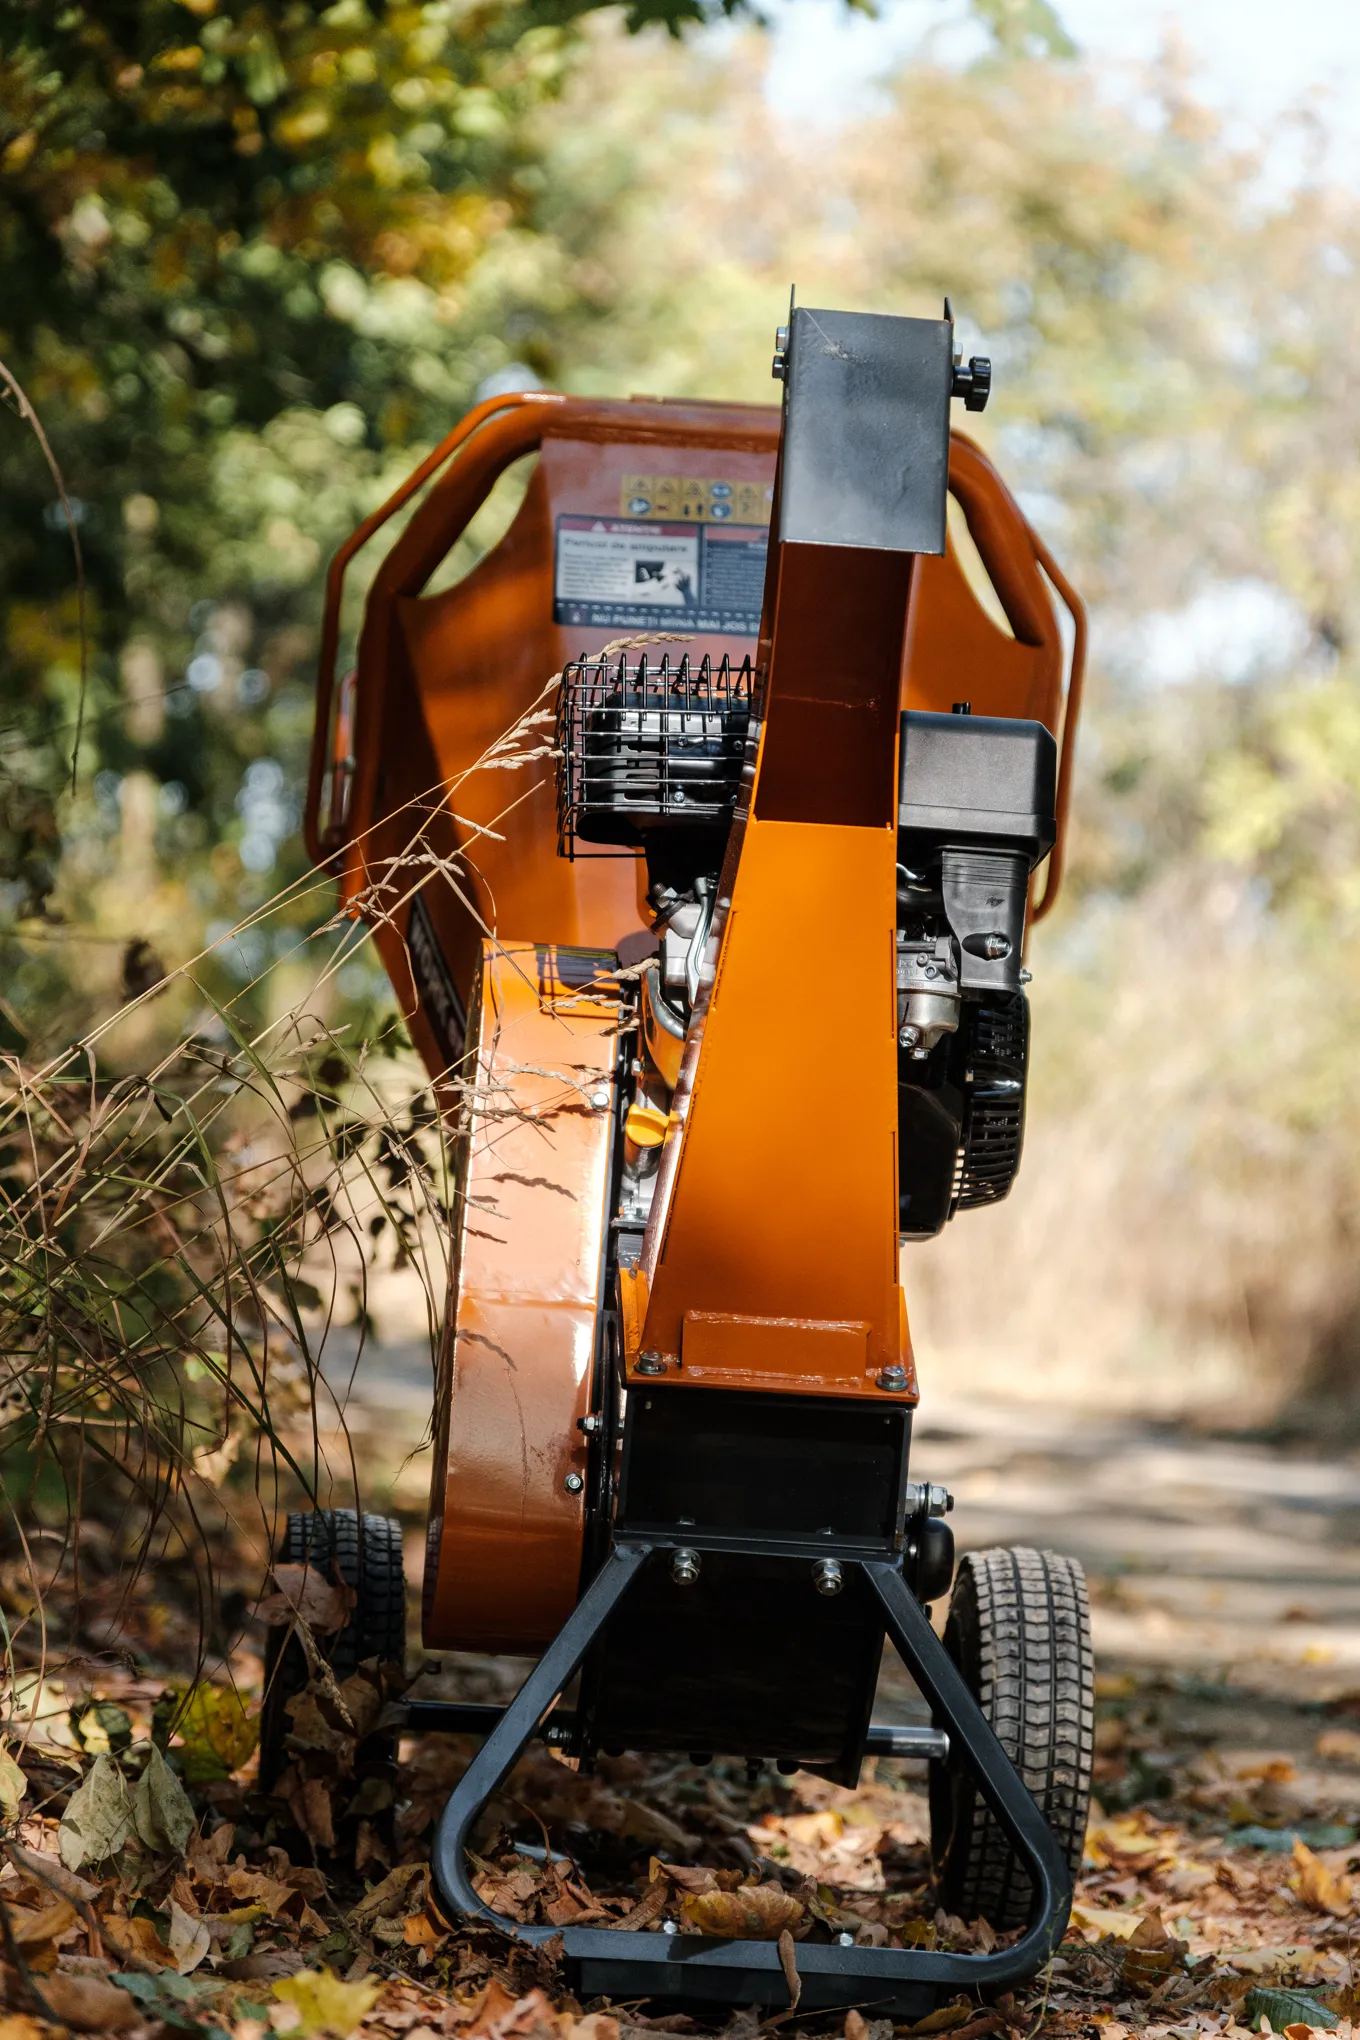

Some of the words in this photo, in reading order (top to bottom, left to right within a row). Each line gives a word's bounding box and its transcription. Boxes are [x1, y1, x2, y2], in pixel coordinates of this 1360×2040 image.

[591, 612, 610, 625] NU
[697, 618, 720, 630] MAI
[721, 620, 748, 632] JOS
